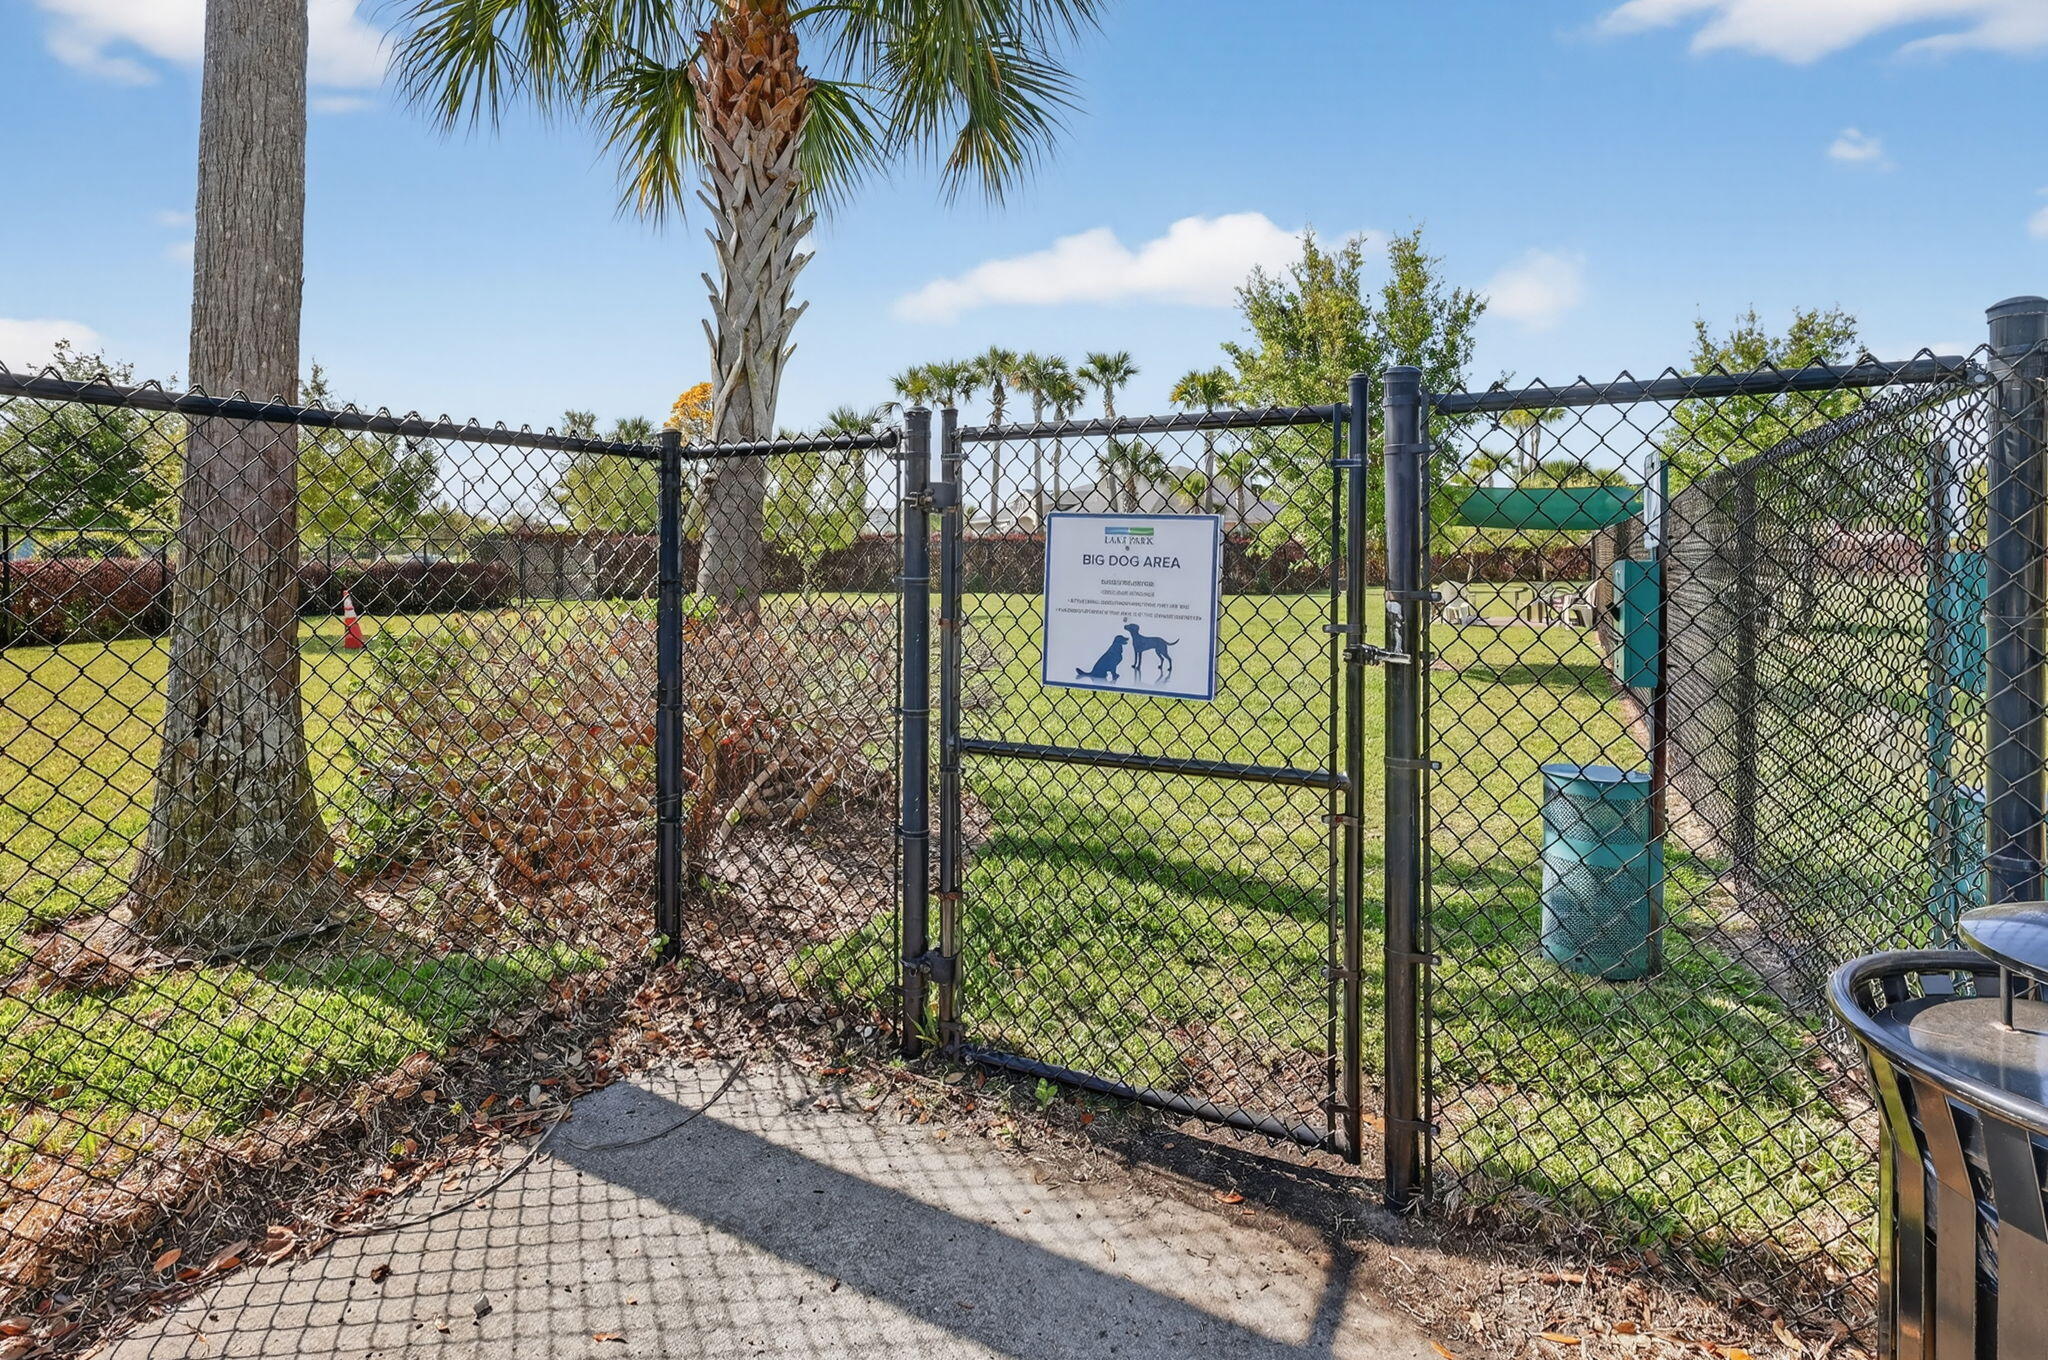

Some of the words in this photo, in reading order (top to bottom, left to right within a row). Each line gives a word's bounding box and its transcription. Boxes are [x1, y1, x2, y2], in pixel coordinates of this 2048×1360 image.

[1083, 554, 1105, 566] BIG
[1109, 555, 1140, 567] DOG
[1143, 556, 1181, 569] AREA
